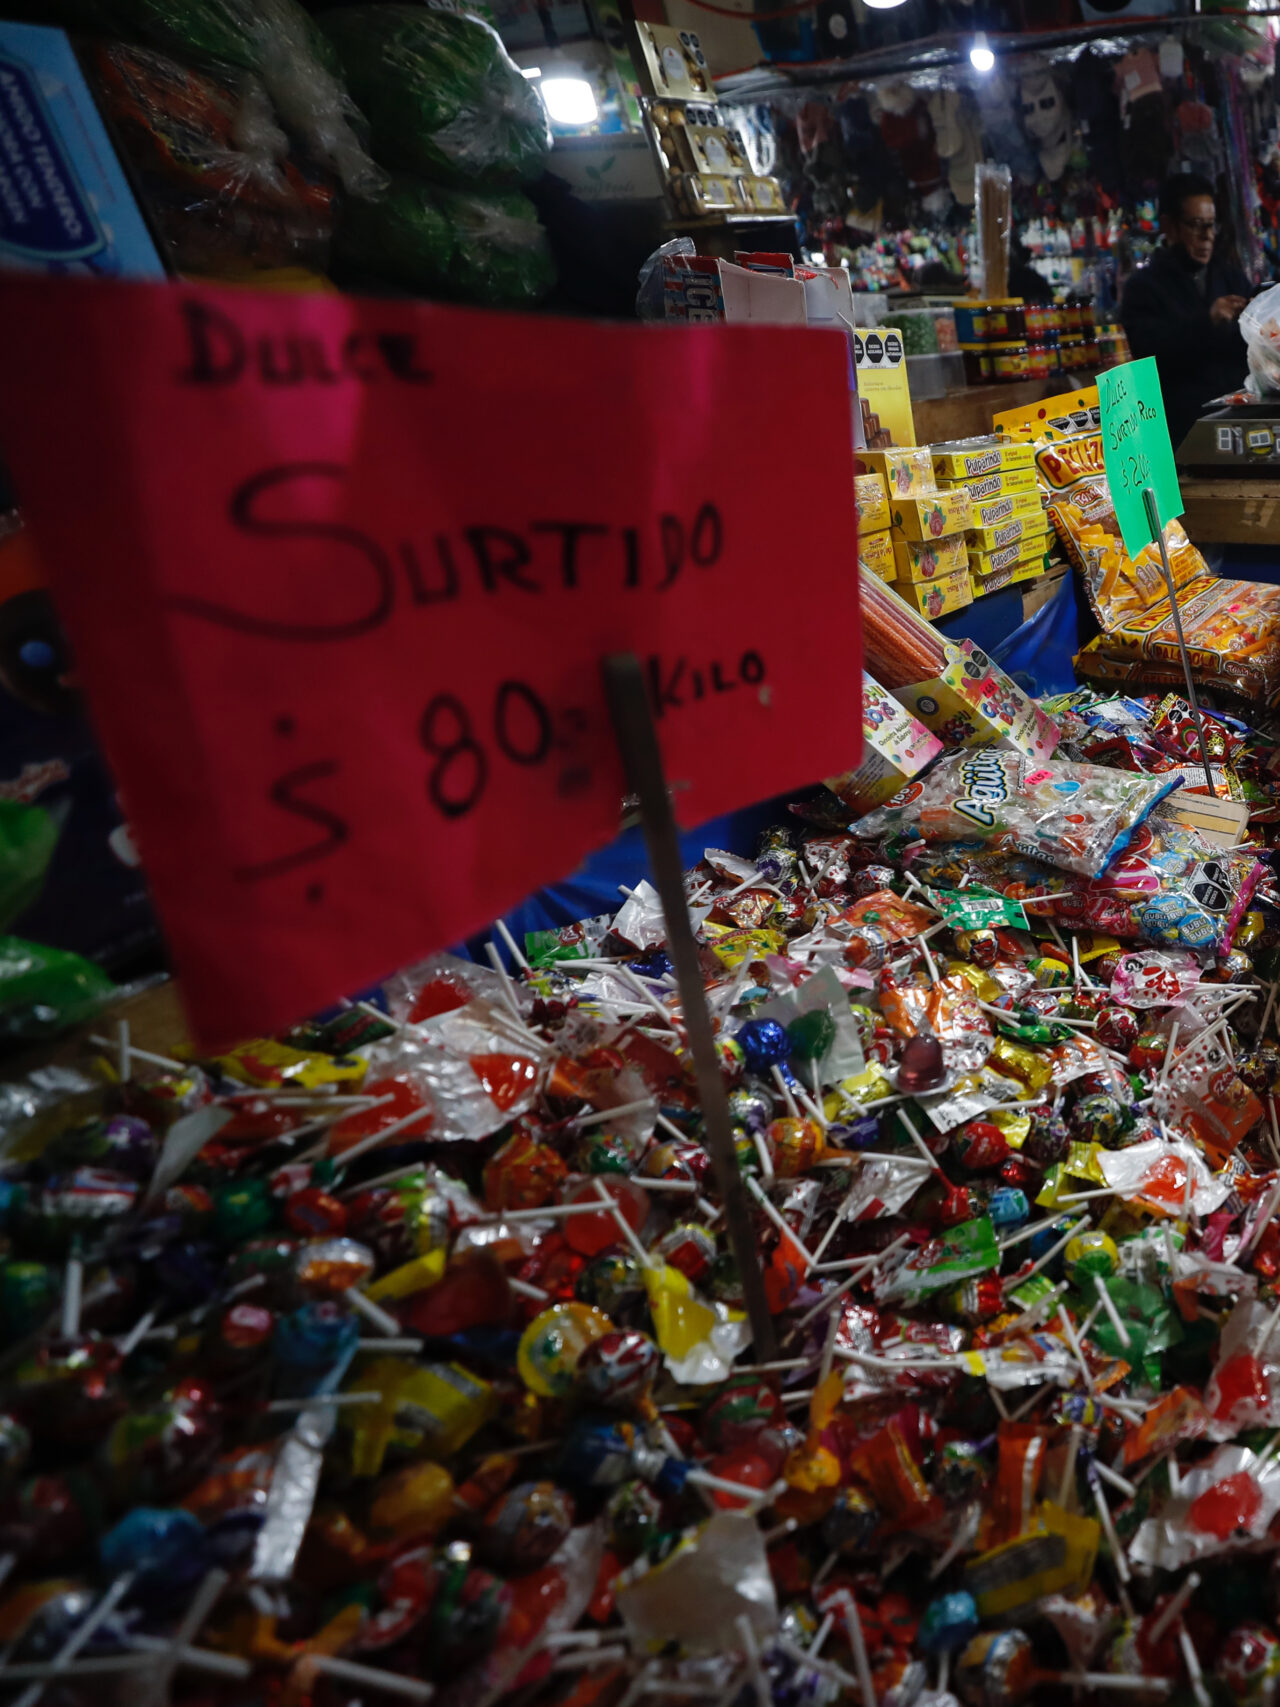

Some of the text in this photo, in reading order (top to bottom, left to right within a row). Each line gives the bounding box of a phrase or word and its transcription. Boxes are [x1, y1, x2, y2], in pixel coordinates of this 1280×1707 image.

[964, 450, 1002, 475] Pulparindo
[981, 498, 1013, 526] Pulparindo
[993, 520, 1022, 547] Pulparindo
[168, 462, 722, 641] SURTIDO
[990, 543, 1020, 571] Pulparindo
[650, 650, 764, 719] KILO
[1182, 918, 1208, 934] BUBLI
